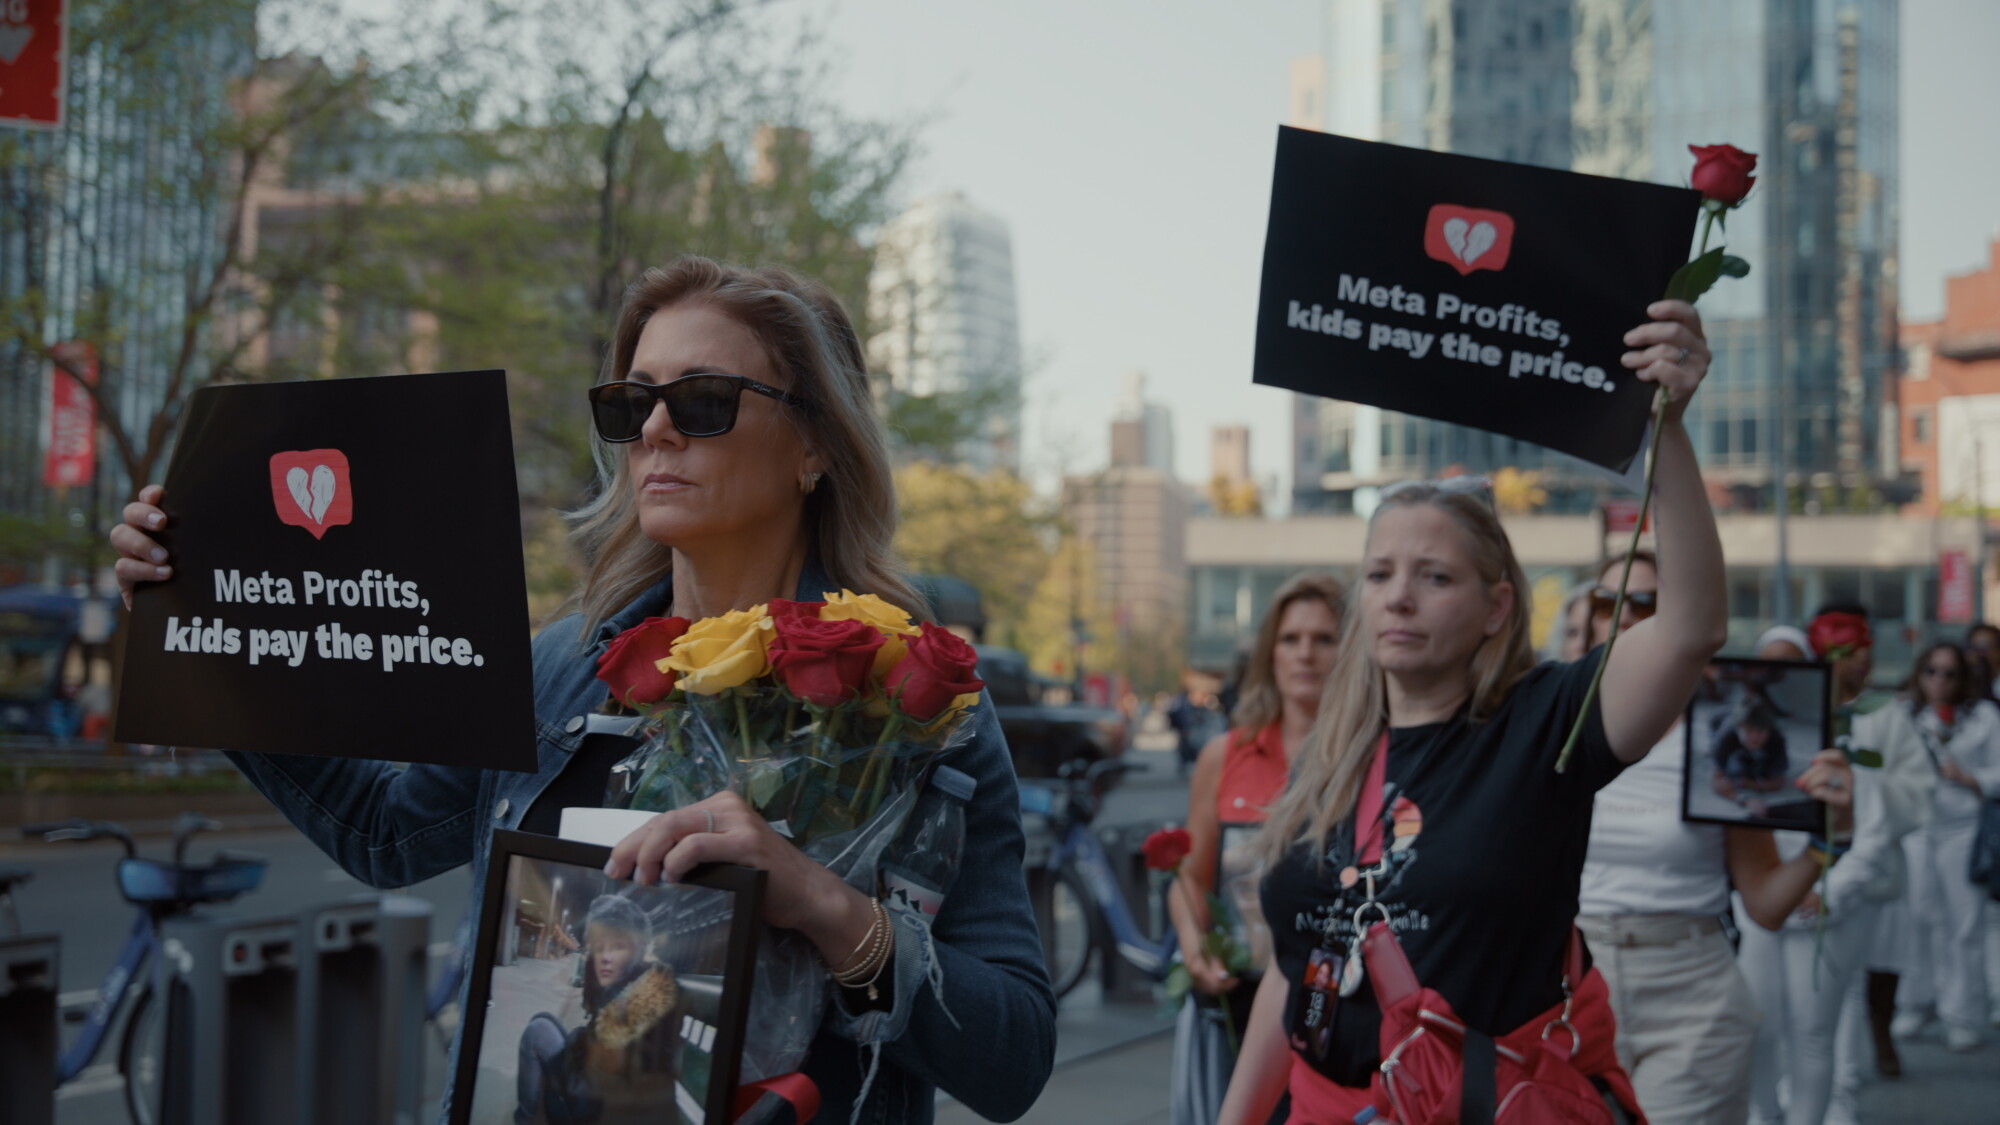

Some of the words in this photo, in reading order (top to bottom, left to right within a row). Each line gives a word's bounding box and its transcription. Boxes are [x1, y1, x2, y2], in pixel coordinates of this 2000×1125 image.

[1337, 273, 1426, 316] Meta
[1436, 293, 1570, 348] Profits,
[1287, 300, 1362, 340] kids
[1368, 323, 1435, 359] pay
[1440, 332, 1503, 366] the
[1508, 350, 1615, 393] price.
[213, 568, 296, 605] Meta
[302, 568, 430, 617] Profits,
[163, 616, 242, 655] kids
[249, 628, 309, 668] pay
[314, 622, 374, 661] the
[381, 624, 485, 673] price.
